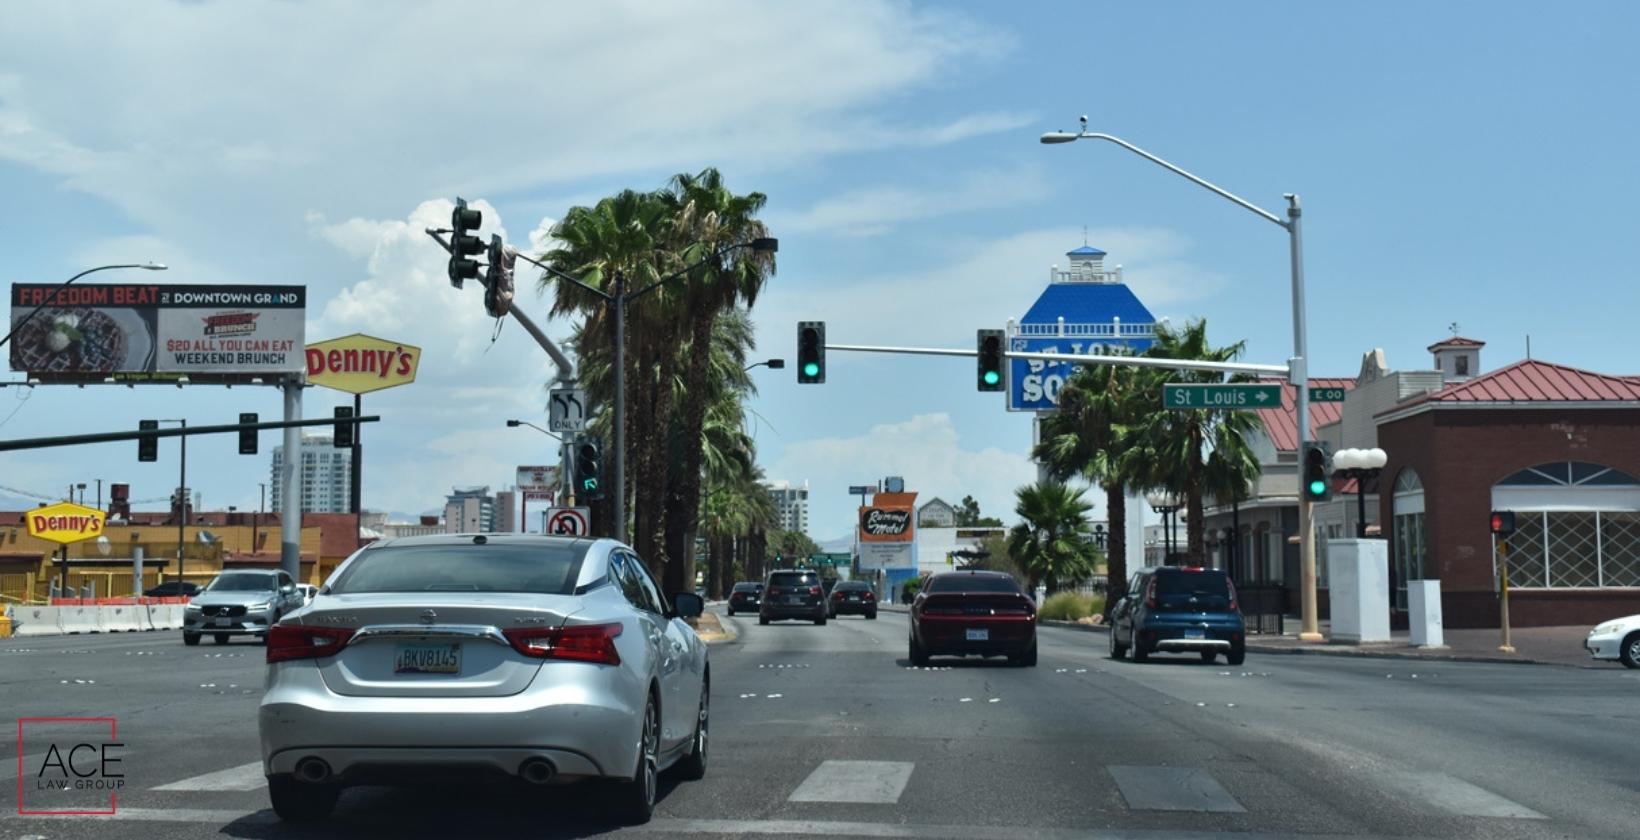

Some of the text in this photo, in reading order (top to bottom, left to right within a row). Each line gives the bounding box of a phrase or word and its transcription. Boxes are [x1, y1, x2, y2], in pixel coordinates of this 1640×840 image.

[20, 287, 108, 304] FREEDOM
[113, 287, 158, 304] BEAT
[174, 293, 251, 304] DOWNTOWN
[254, 293, 297, 304] GRAND
[167, 340, 294, 352] $20 ALL YOU CAN EAT
[175, 353, 285, 364] WEEKEND BRUNCH
[304, 347, 412, 378] Denny's
[1175, 389, 1246, 405] St Louis
[1315, 391, 1322, 399] E
[554, 420, 581, 429] ONLY
[33, 514, 101, 534] Denny's
